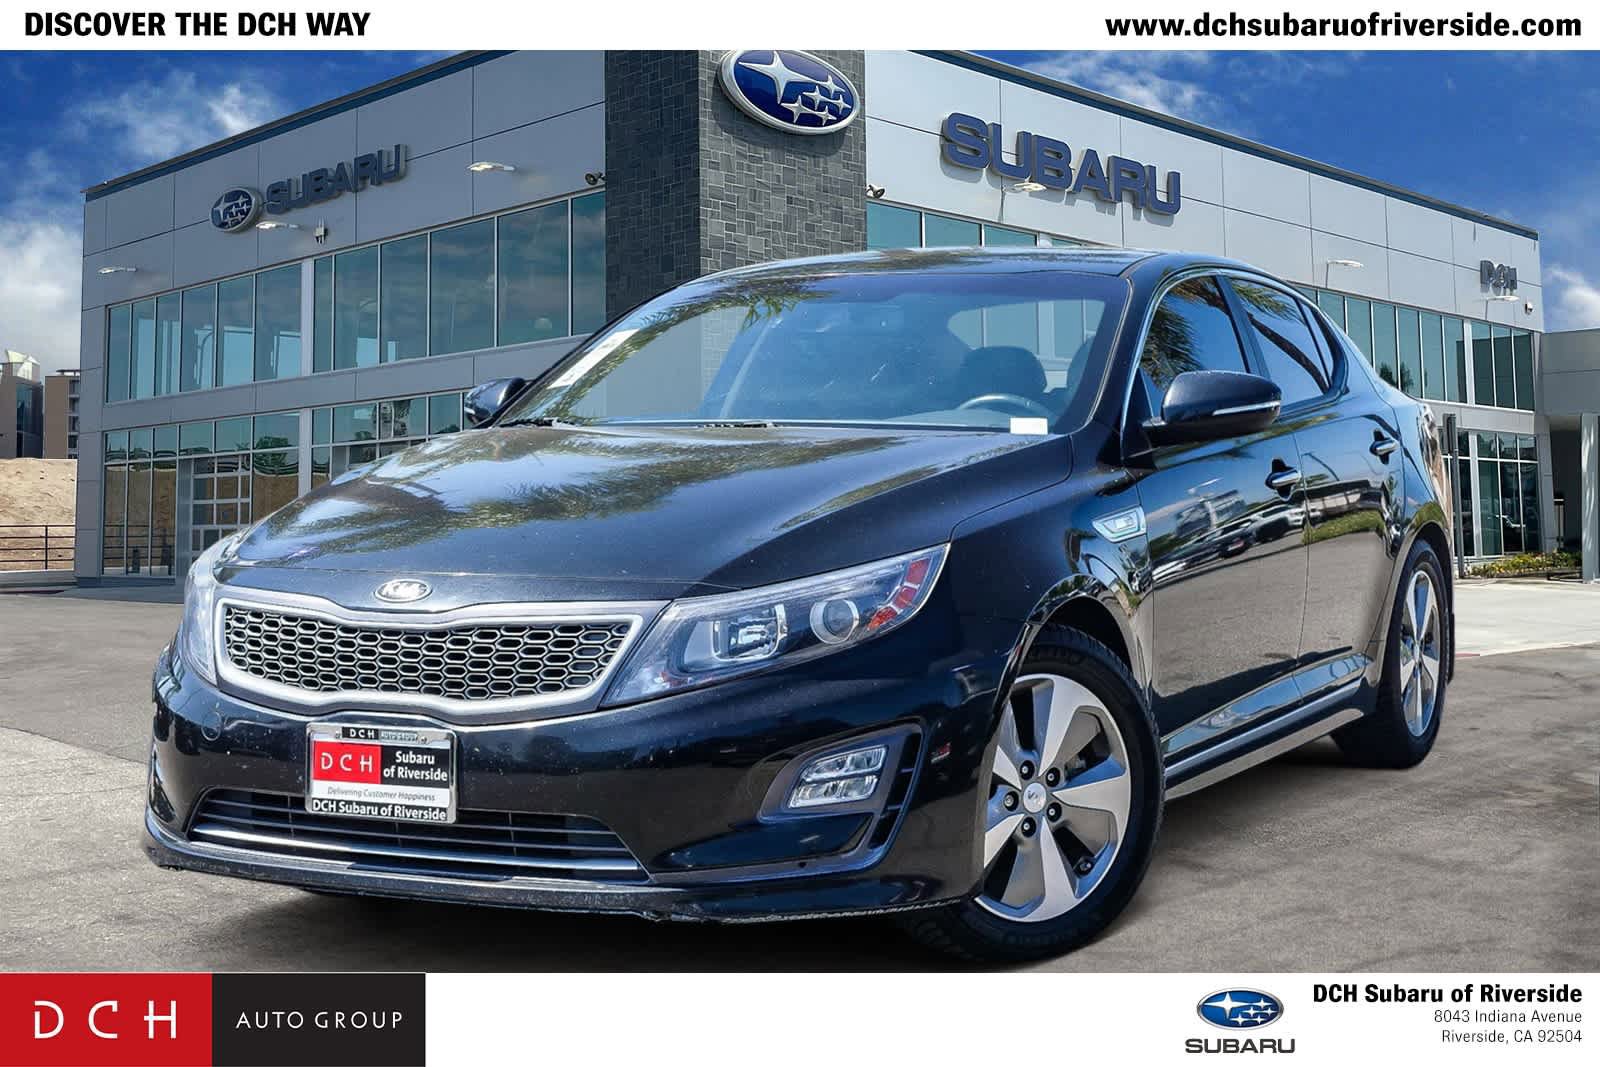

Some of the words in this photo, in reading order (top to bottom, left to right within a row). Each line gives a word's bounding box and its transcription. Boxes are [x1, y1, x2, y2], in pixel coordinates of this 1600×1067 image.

[941, 112, 1182, 216] SUBARU
[265, 143, 408, 216] SUBARU
[349, 729, 375, 739] DCH
[320, 752, 373, 773] DCH
[395, 750, 435, 765] Subaru
[383, 766, 395, 778] of
[397, 766, 448, 781] Riverside
[327, 786, 362, 798] Delivering
[363, 789, 397, 799] Customer
[312, 799, 337, 812] DCH
[338, 801, 378, 816] Subaru
[380, 804, 393, 817] of
[394, 805, 447, 821] Riverside
